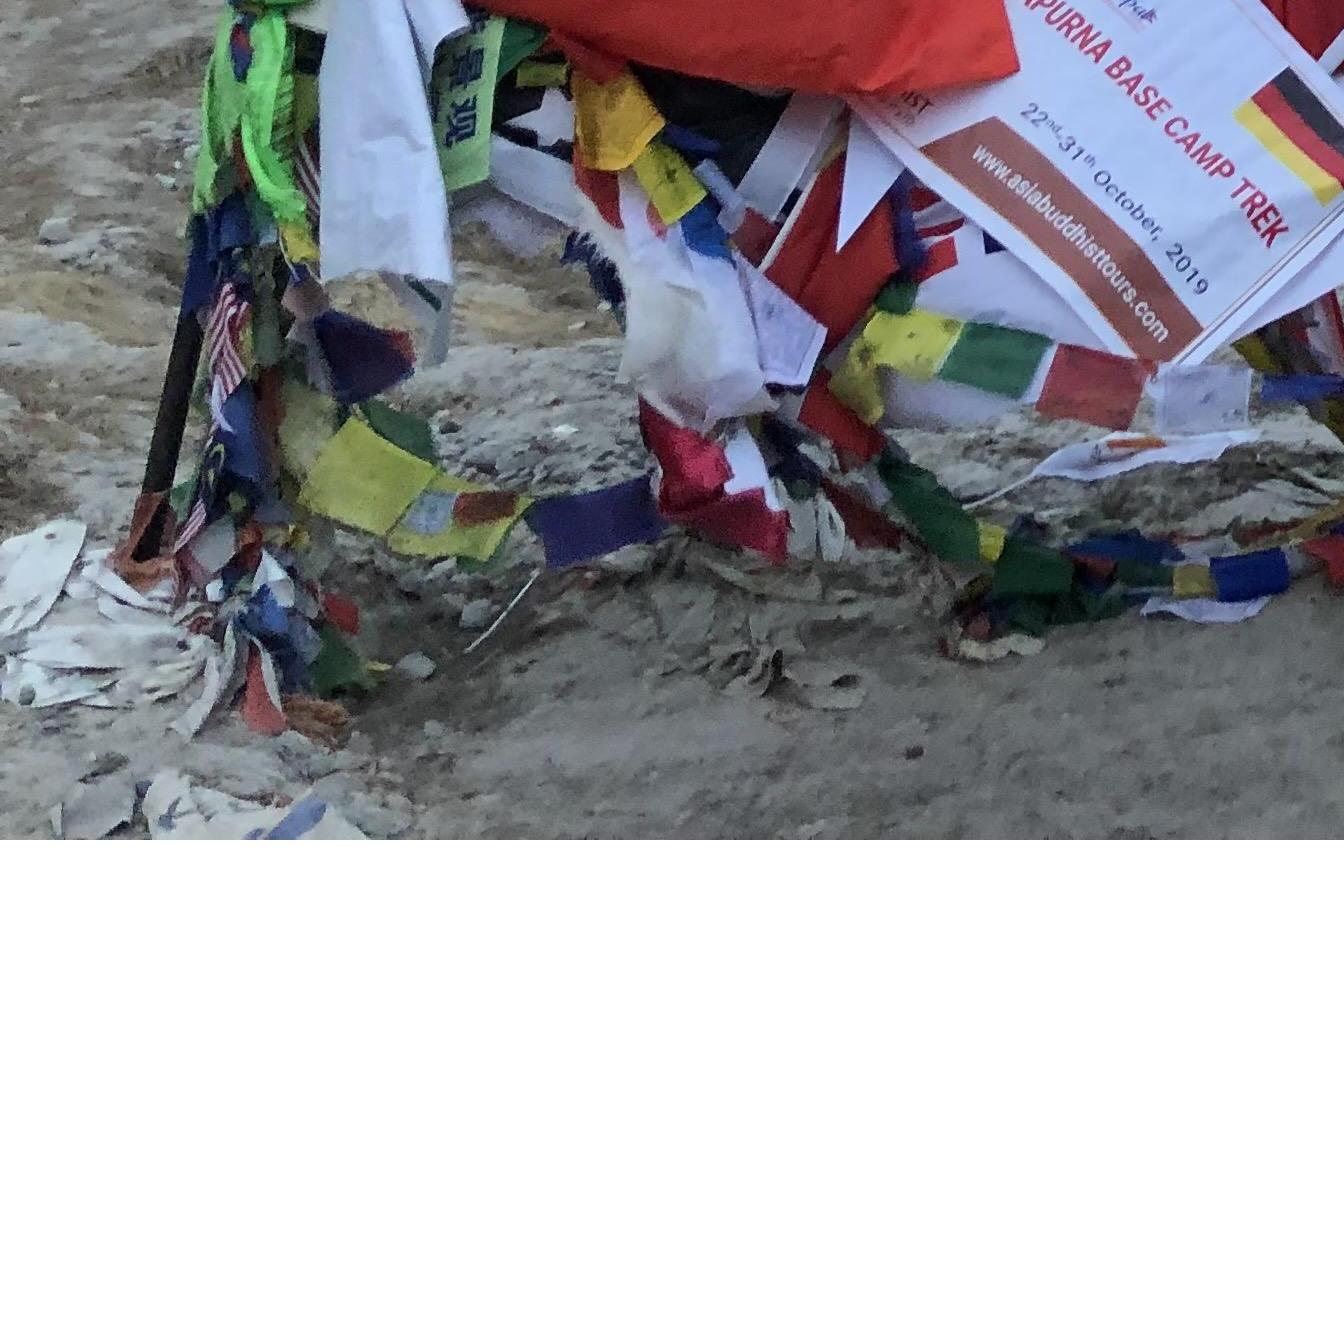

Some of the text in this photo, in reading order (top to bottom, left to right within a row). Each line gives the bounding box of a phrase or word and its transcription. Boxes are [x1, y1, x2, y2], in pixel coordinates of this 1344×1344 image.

[972, 143, 1171, 345] www.asiabuddhisttours.com
[1093, 168, 1164, 242] October,
[1164, 241, 1210, 295] 2019
[1104, 55, 1174, 122] BASE
[1163, 115, 1236, 182] CAMP
[1230, 175, 1291, 252] TREK
